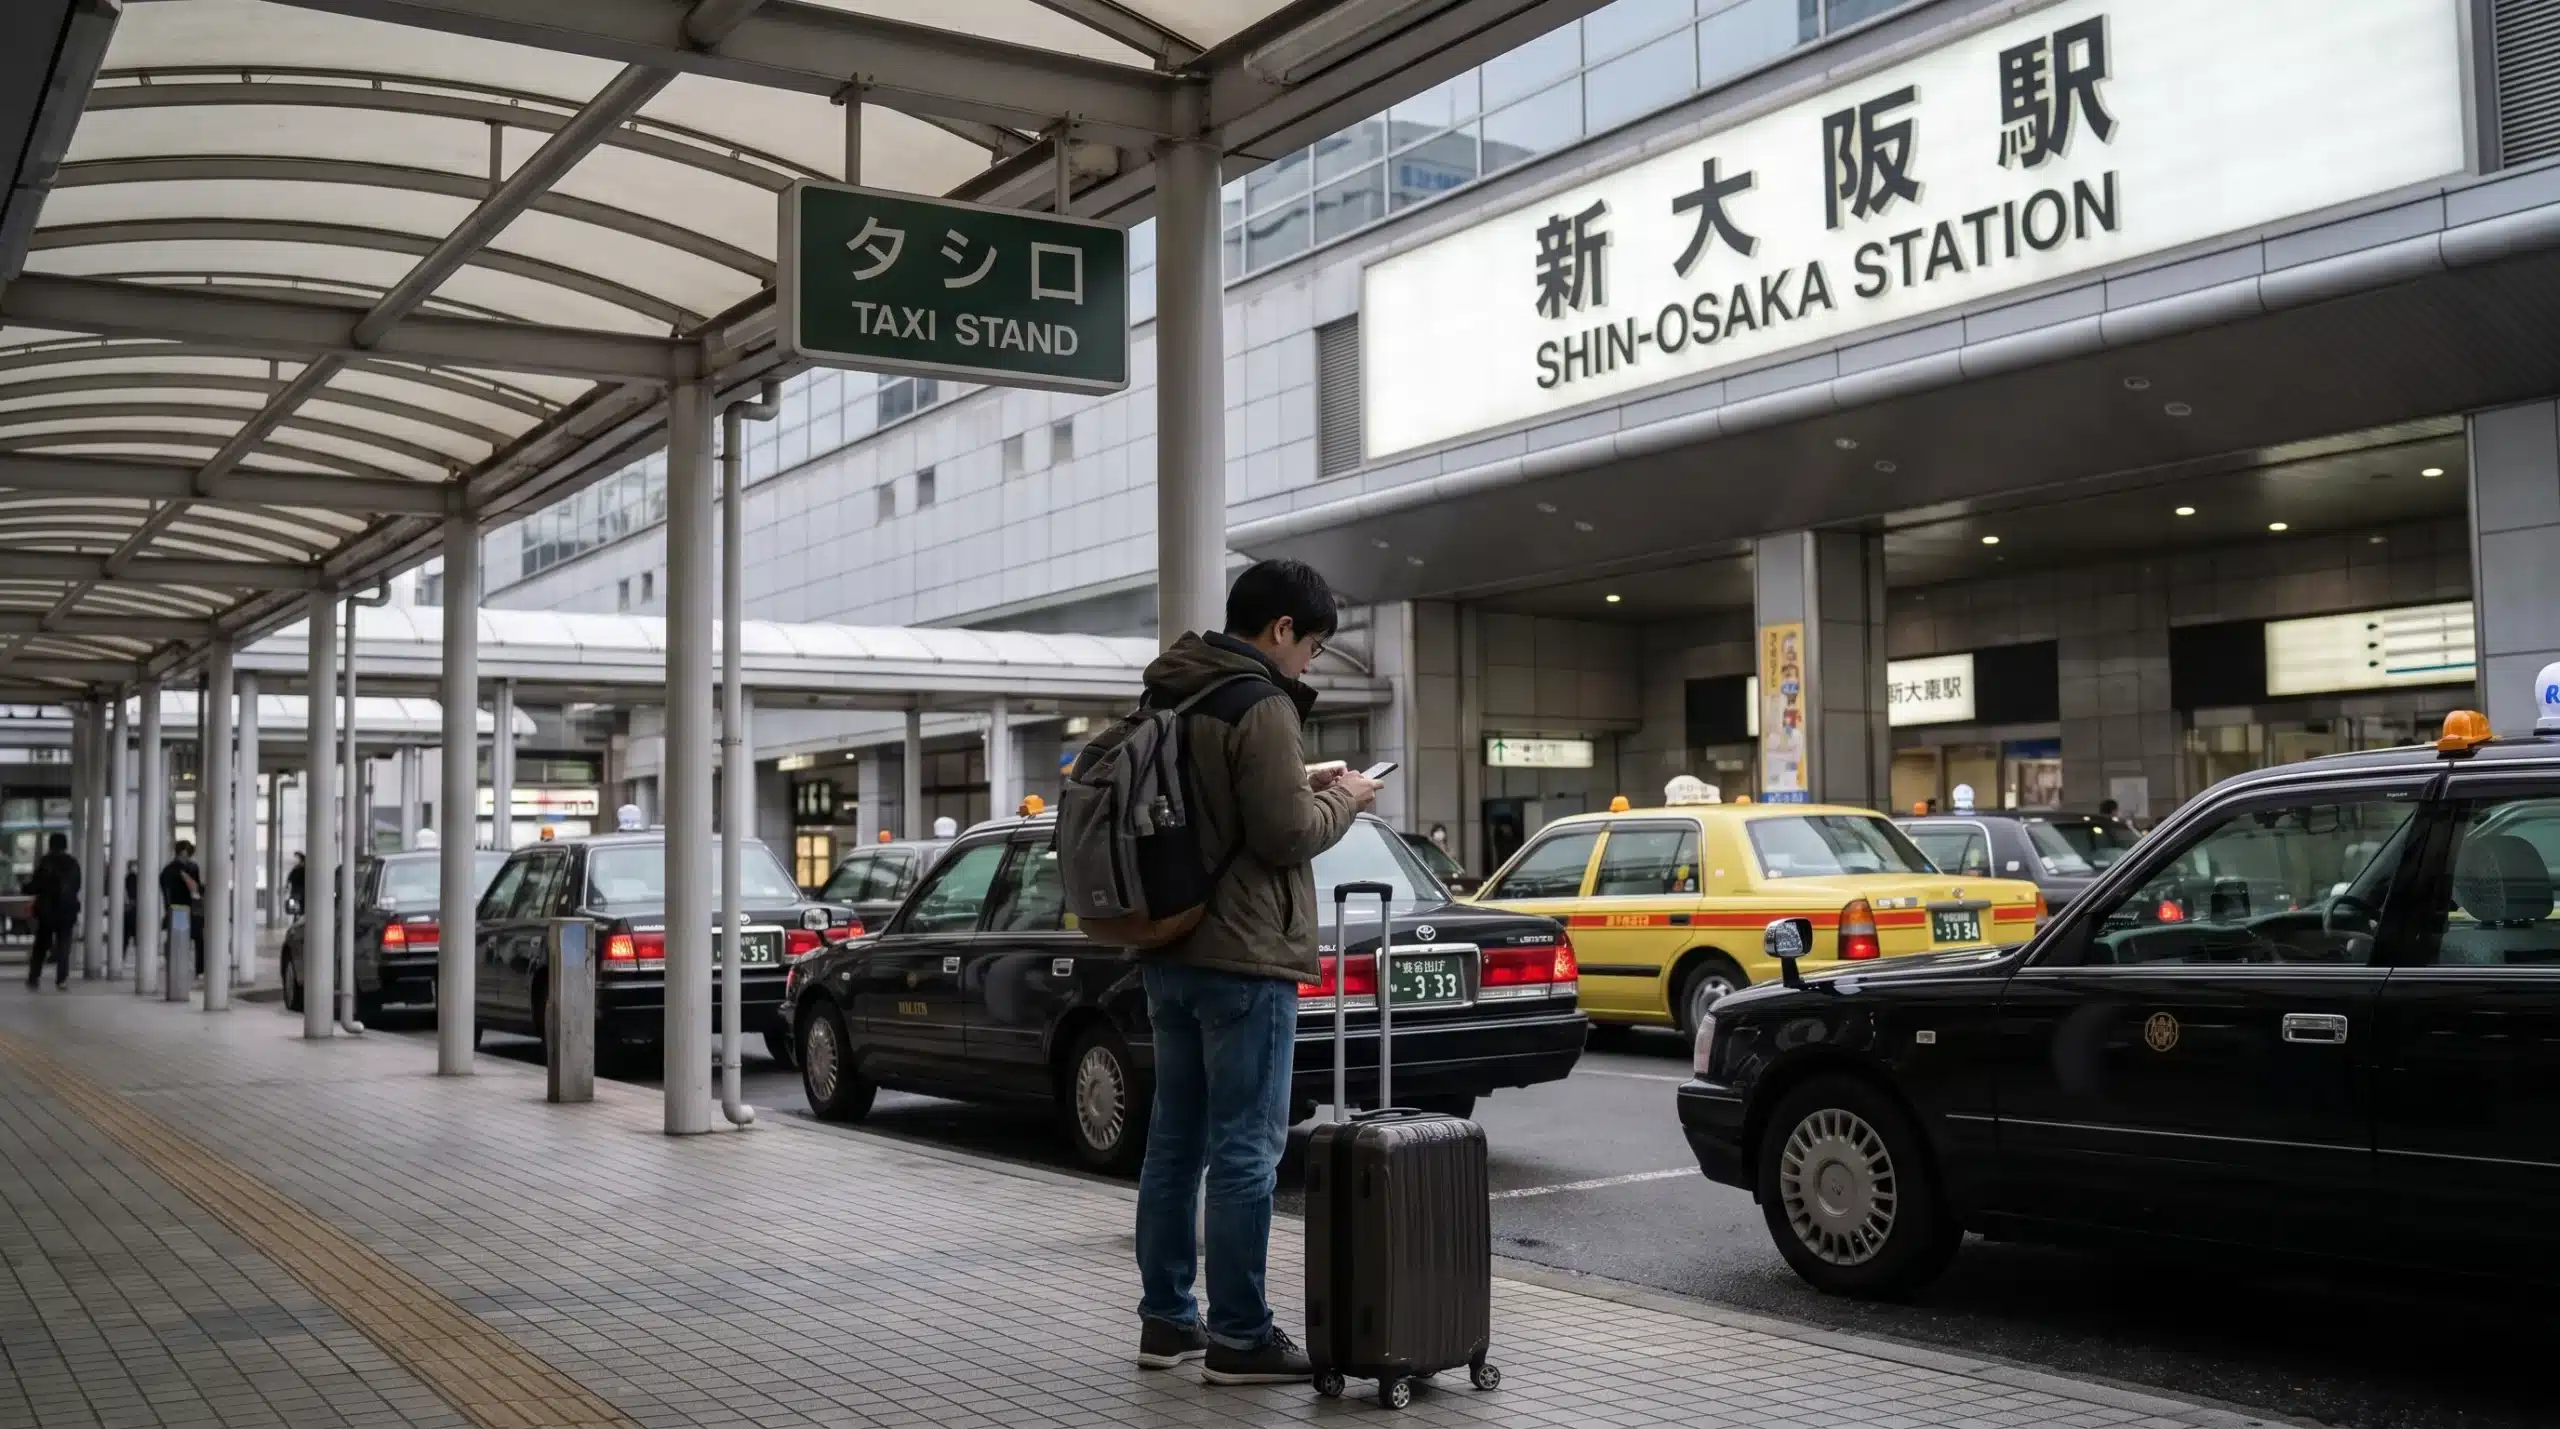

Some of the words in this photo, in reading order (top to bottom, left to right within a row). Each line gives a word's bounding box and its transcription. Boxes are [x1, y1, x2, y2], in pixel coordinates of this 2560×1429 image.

[1535, 13, 2118, 319] 新大阪駅
[852, 300, 936, 341] TAXI
[955, 313, 1079, 356] STAND
[1536, 261, 1833, 389] SHIN-OSAKA
[1854, 171, 2117, 299] STATION
